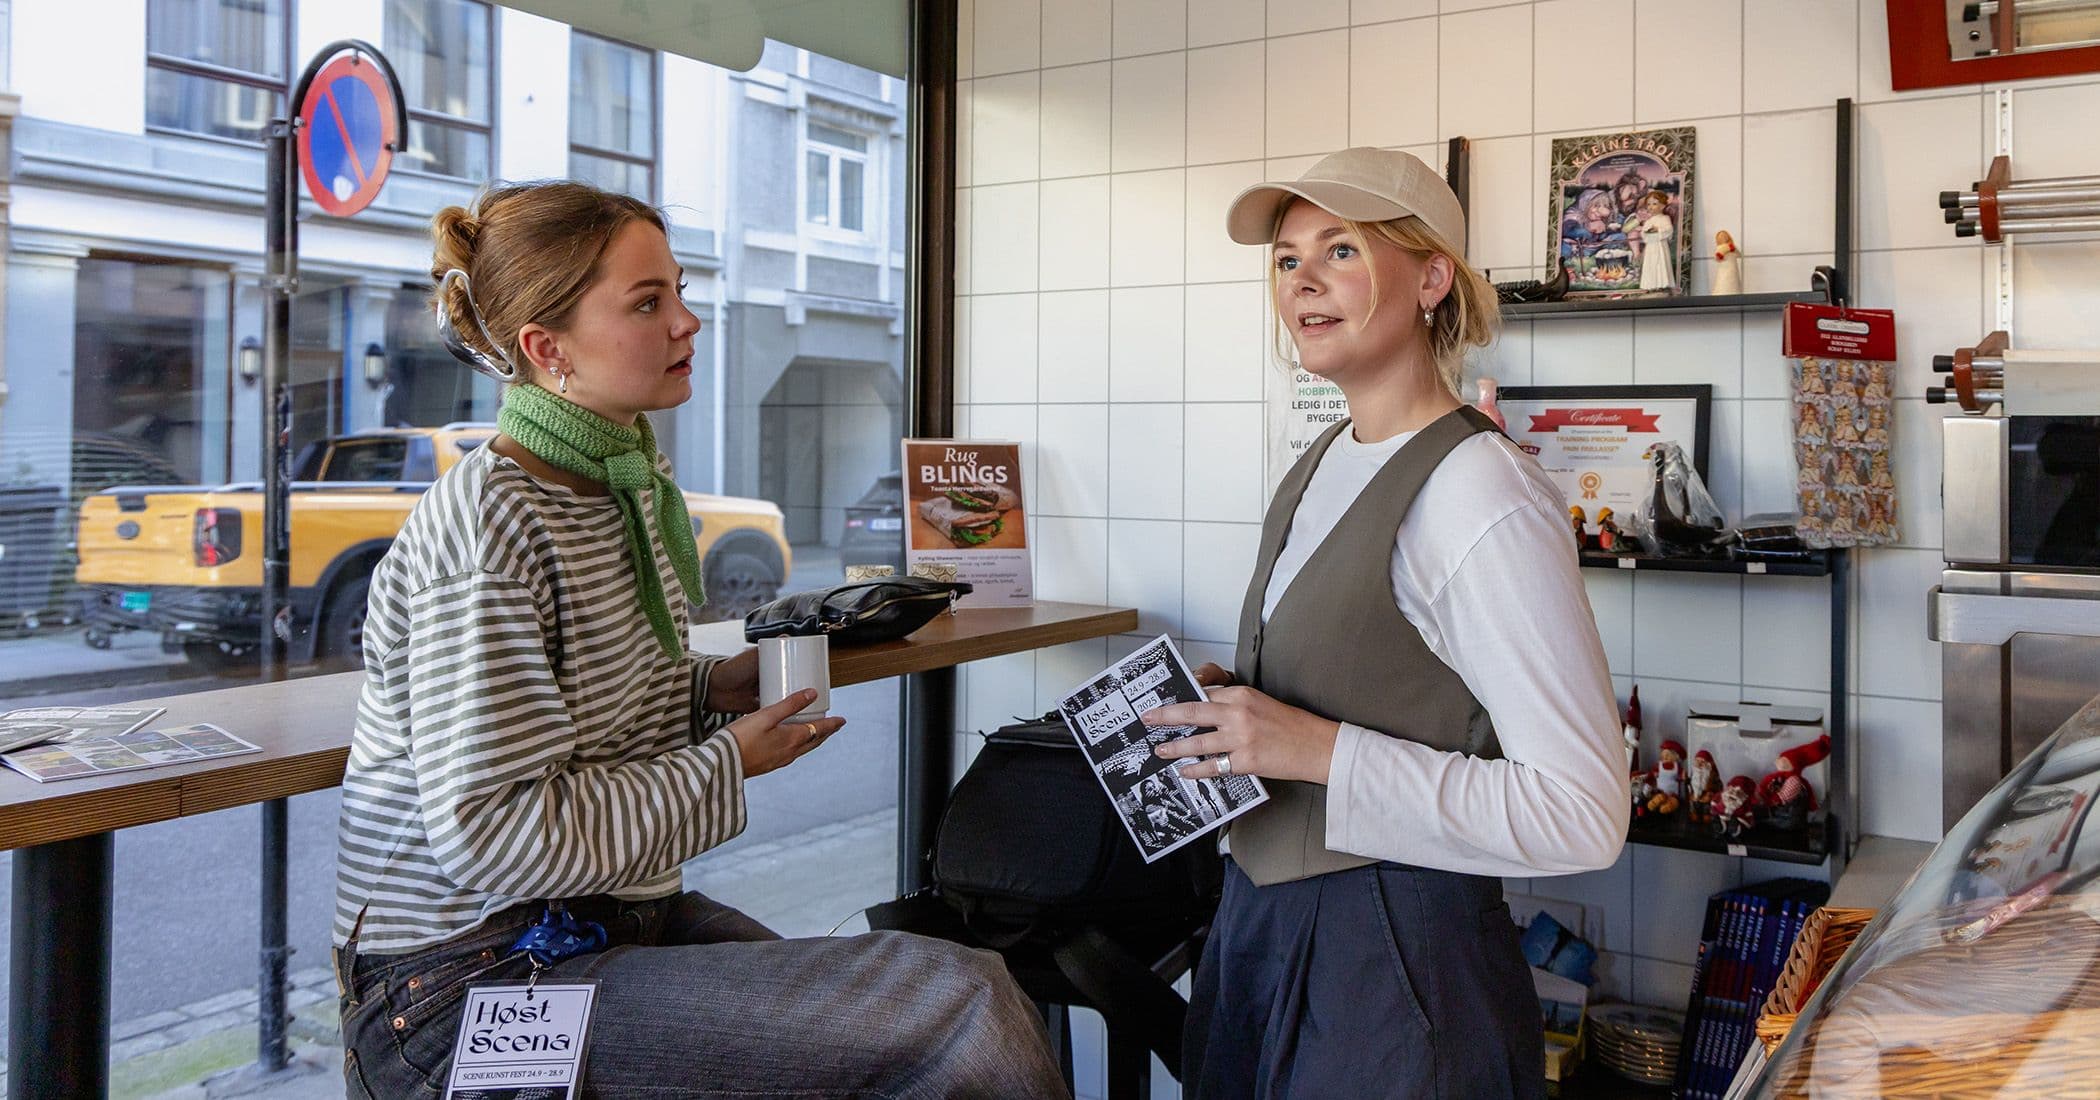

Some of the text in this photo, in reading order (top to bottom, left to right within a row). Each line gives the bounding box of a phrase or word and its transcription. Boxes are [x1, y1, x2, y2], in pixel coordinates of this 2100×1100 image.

[1572, 138, 1630, 169] KLEINE
[1638, 138, 1675, 162] TROL
[1296, 374, 1310, 383] OG
[1298, 387, 1344, 396] HOBBYRO
[1292, 401, 1320, 410] LEDIG
[1329, 400, 1347, 409] DET
[1307, 414, 1345, 423] BYGGET
[1568, 408, 1622, 425] Certificate
[1290, 441, 1302, 449] Vil
[944, 447, 979, 467] Rug
[921, 465, 1008, 484] BLINGS
[1127, 683, 1144, 697] 24.9
[1149, 669, 1166, 683] 28.9
[1137, 696, 1158, 712] 2025
[1081, 702, 1115, 727] Høst
[475, 999, 552, 1030] Høst
[469, 1029, 571, 1054] Scena
[463, 1072, 486, 1081] SCENE
[486, 1071, 509, 1080] KUNST
[509, 1070, 527, 1079] FEST
[527, 1069, 542, 1078] 24.9
[548, 1069, 564, 1077] 28.9
